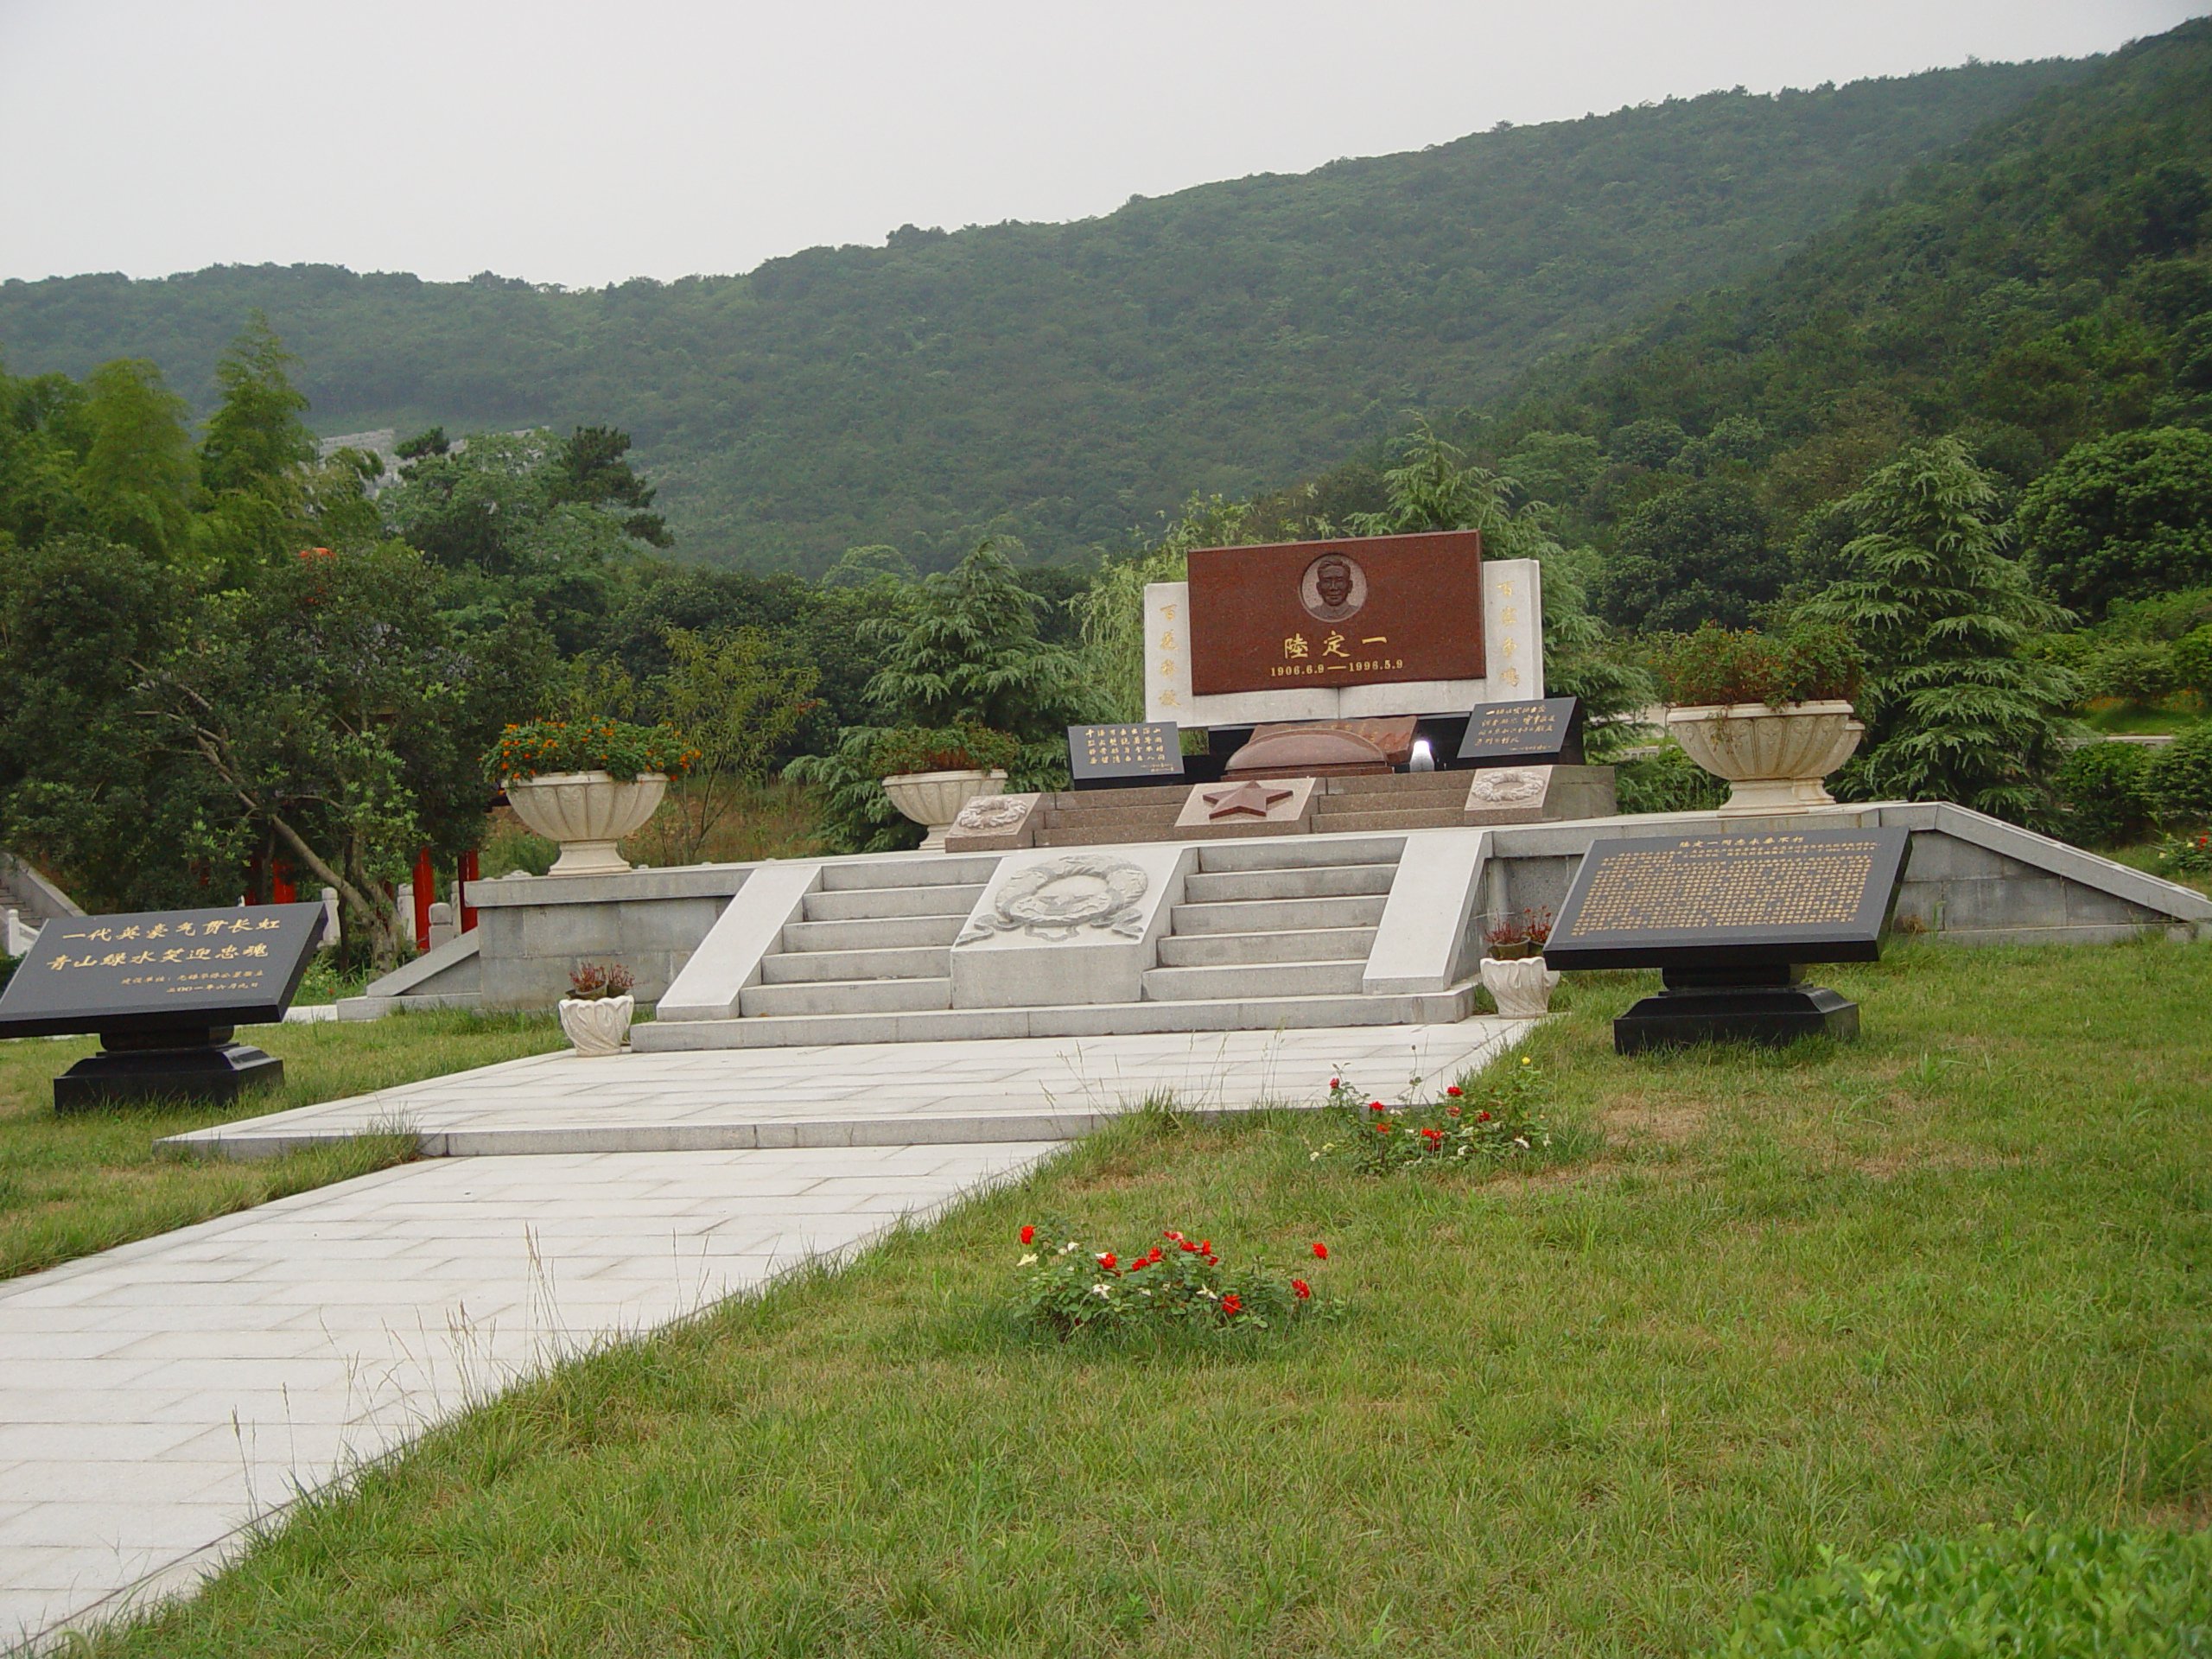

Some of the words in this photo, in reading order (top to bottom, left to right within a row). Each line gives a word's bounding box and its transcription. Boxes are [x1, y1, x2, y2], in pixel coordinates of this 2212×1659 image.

[1284, 630, 1387, 658] 陸定一
[61, 916, 281, 942] 一代英豪气贯长虹
[47, 943, 269, 971] 青山绿水笑迎忠魂
